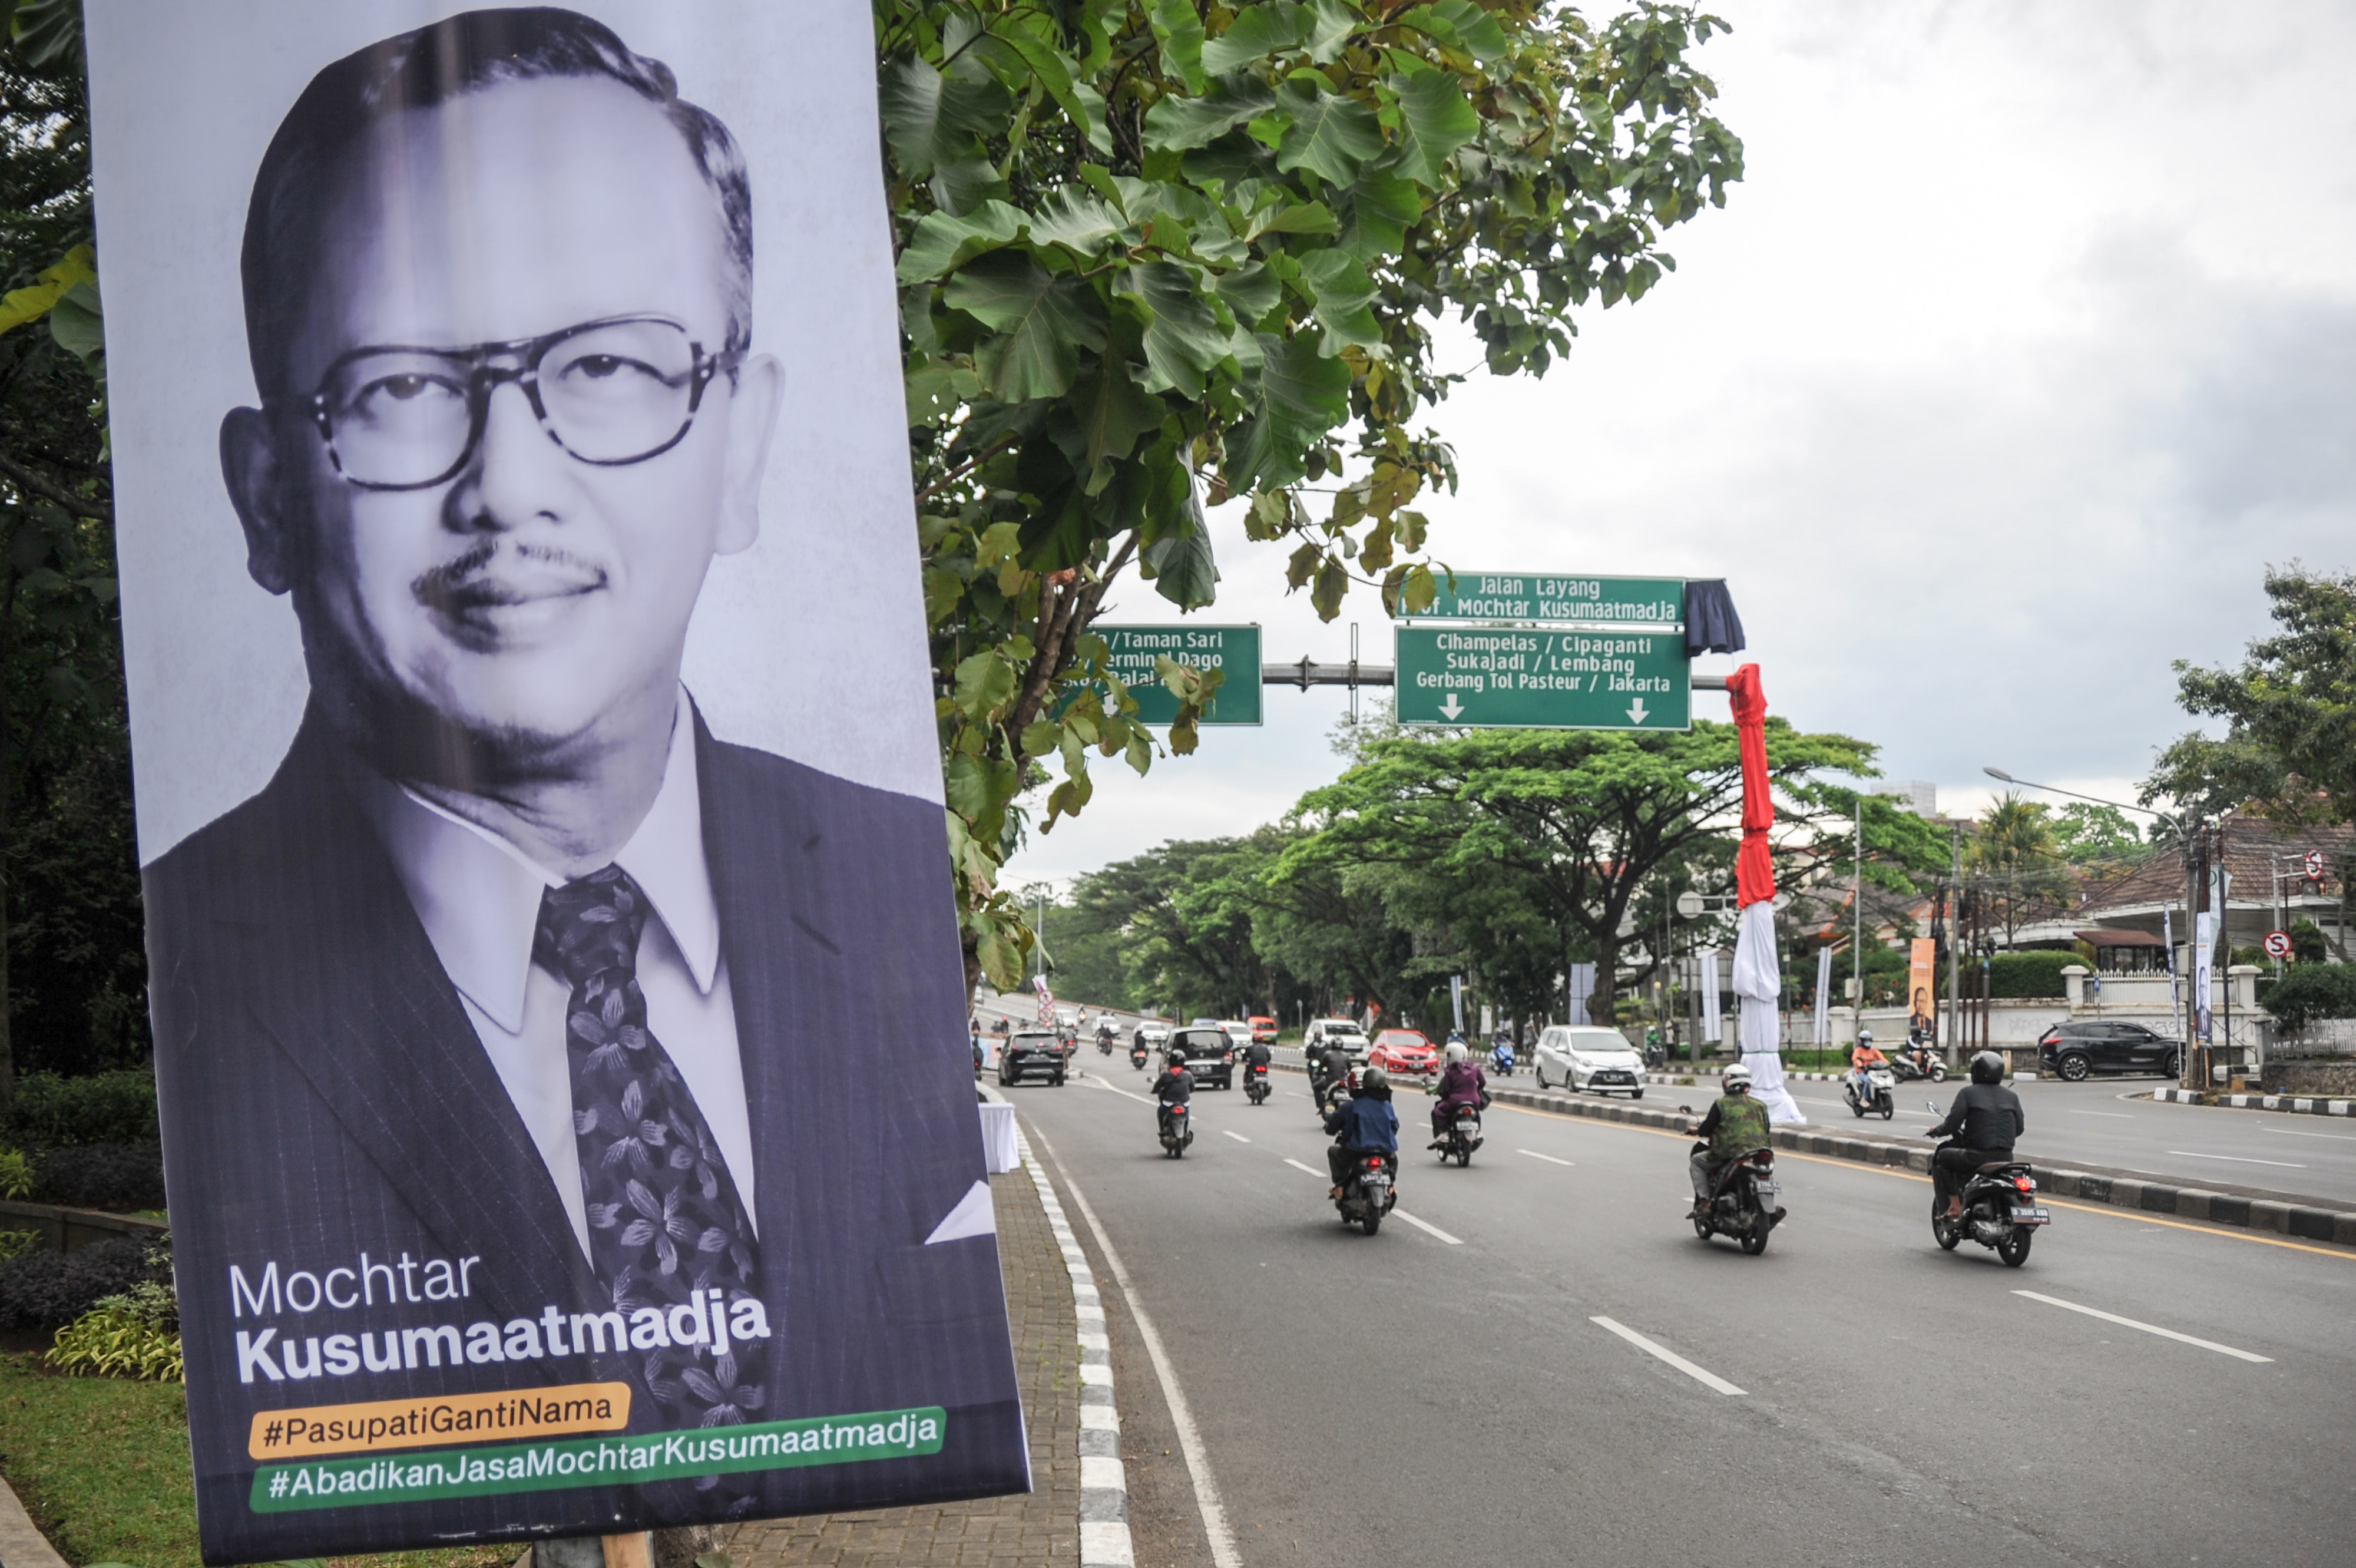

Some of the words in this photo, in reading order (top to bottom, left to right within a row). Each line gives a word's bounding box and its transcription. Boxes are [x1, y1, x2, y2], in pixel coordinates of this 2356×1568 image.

[1479, 577, 1523, 595] Jalan
[1536, 579, 1600, 600] Layang
[1458, 598, 1530, 617] Mochtar
[1540, 600, 1676, 621] Kusumaatmadja
[1187, 631, 1222, 647] Sari
[1437, 633, 1537, 654] Cihampelas
[1562, 636, 1651, 657] Cipaganti
[1179, 651, 1222, 671] Dago
[1447, 653, 1525, 671] Sukajadi
[1551, 655, 1634, 676] Lembang
[1417, 671, 1484, 692] Gerbang
[1489, 672, 1513, 689] Tol
[1519, 673, 1581, 690] Pasteur
[1608, 674, 1670, 692] Jakarta
[230, 1252, 480, 1317] Mochtar
[236, 1288, 771, 1383] Kusumaatmadja
[264, 1397, 612, 1447] #PasupatiGantiNama
[269, 1414, 938, 1498] #AbadikanJasaMochtarKusumaatmadja
